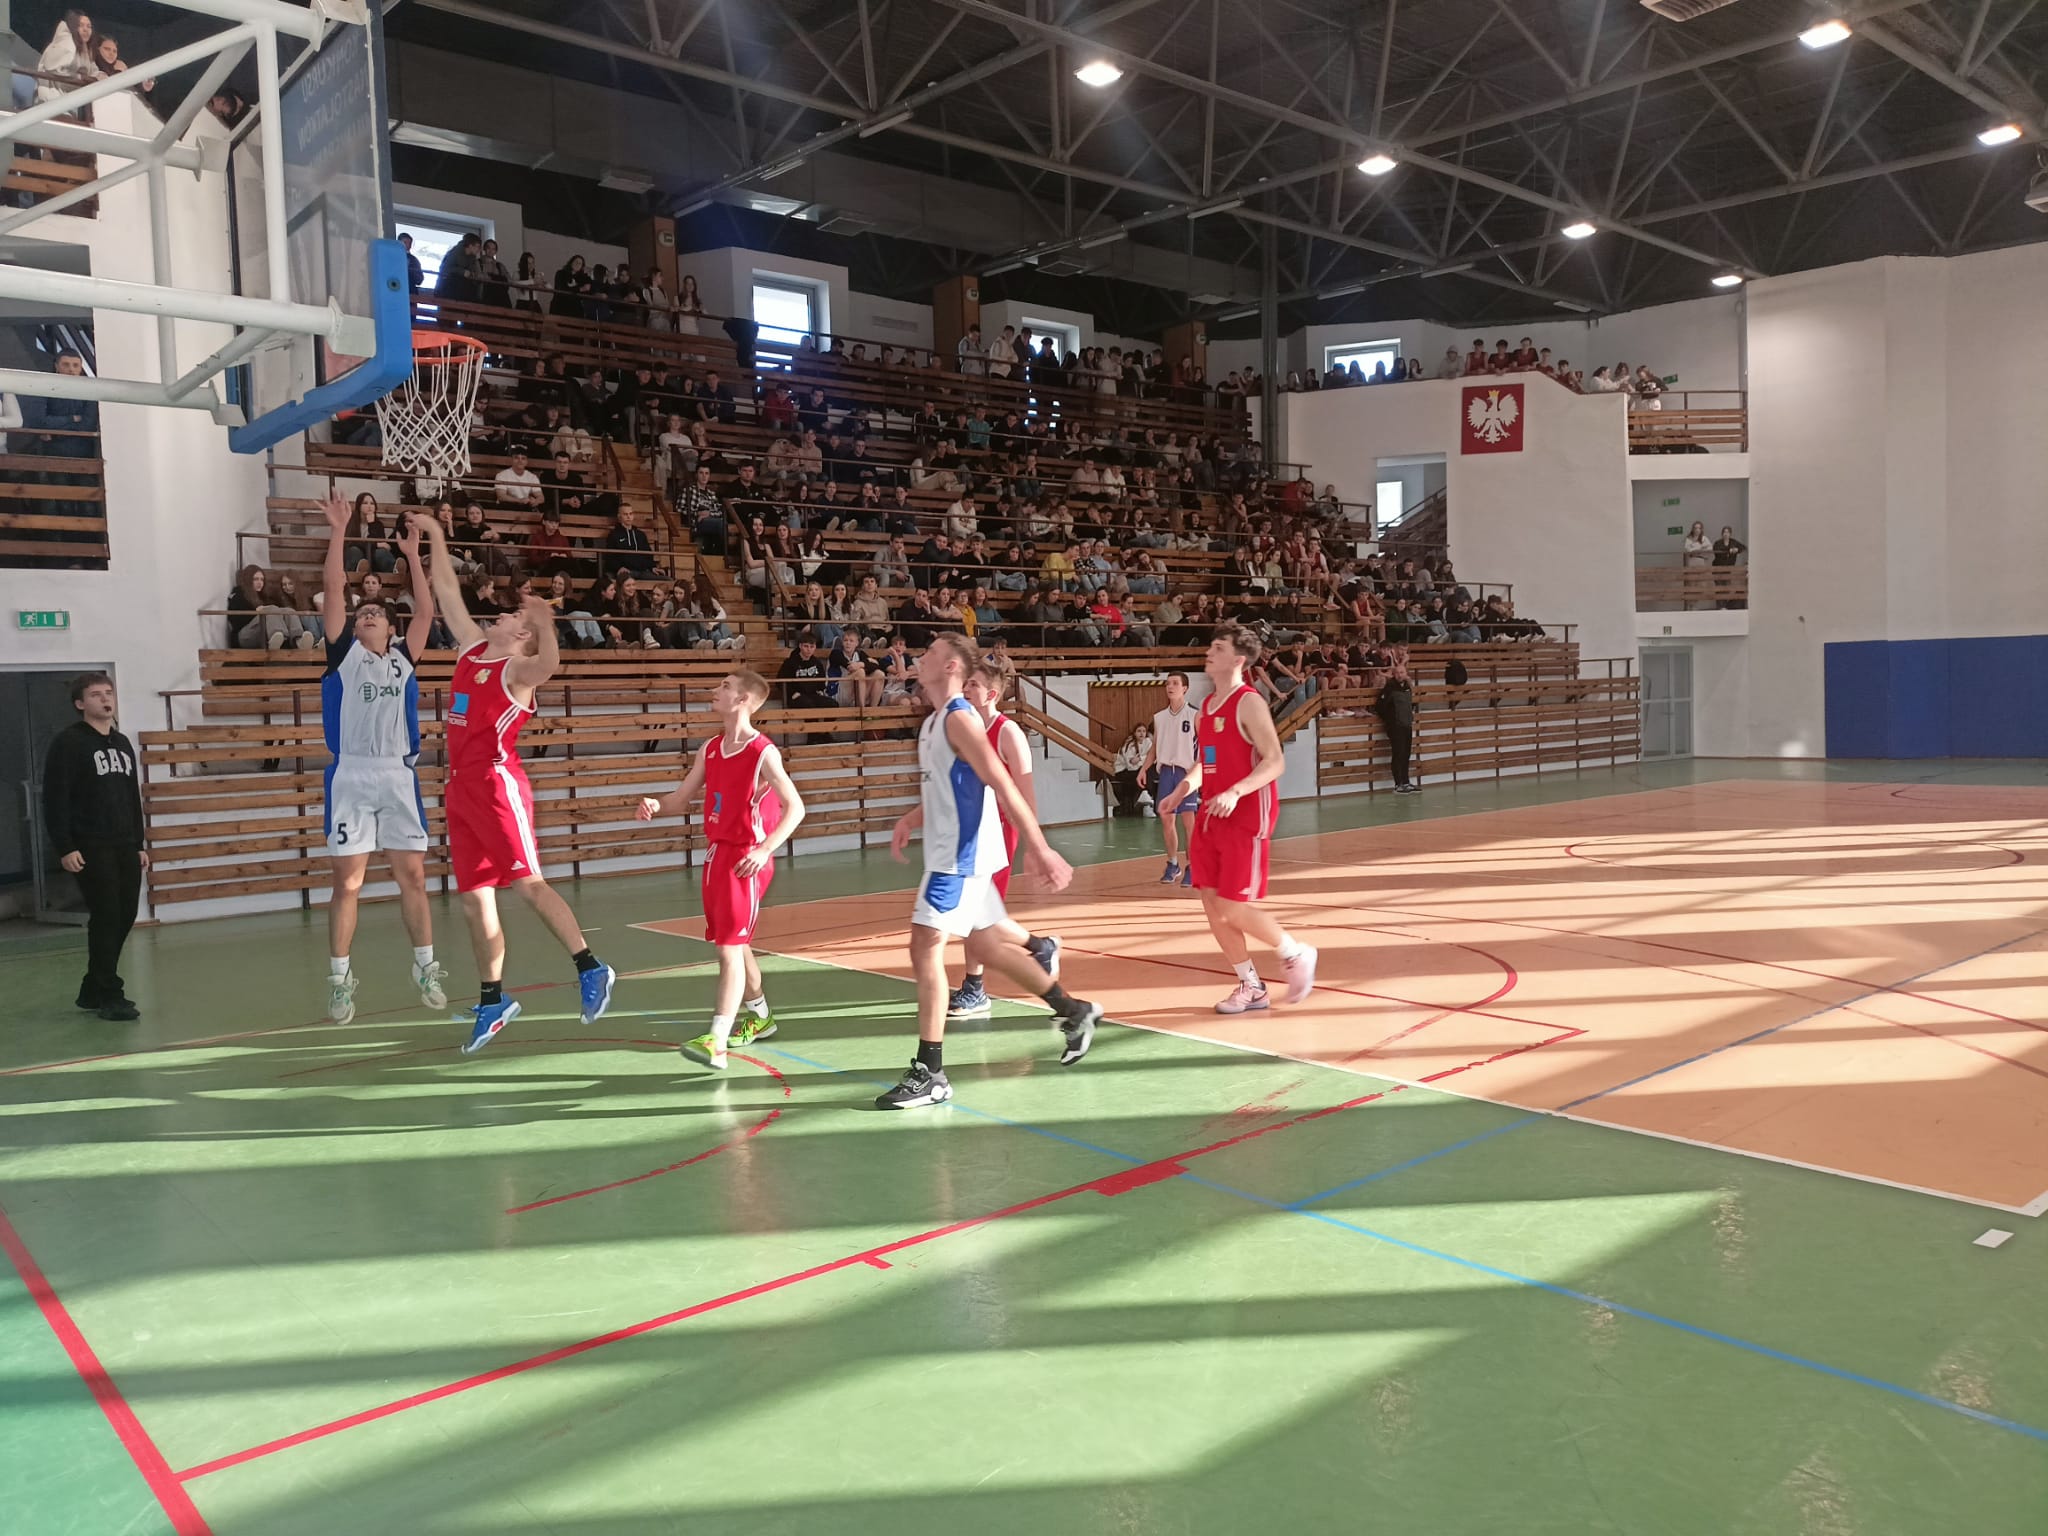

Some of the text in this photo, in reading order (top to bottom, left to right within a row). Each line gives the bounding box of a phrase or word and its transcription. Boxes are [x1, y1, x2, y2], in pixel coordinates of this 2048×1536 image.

[390, 658, 402, 678] 5
[1182, 720, 1190, 733] 6
[337, 822, 348, 845] 5
